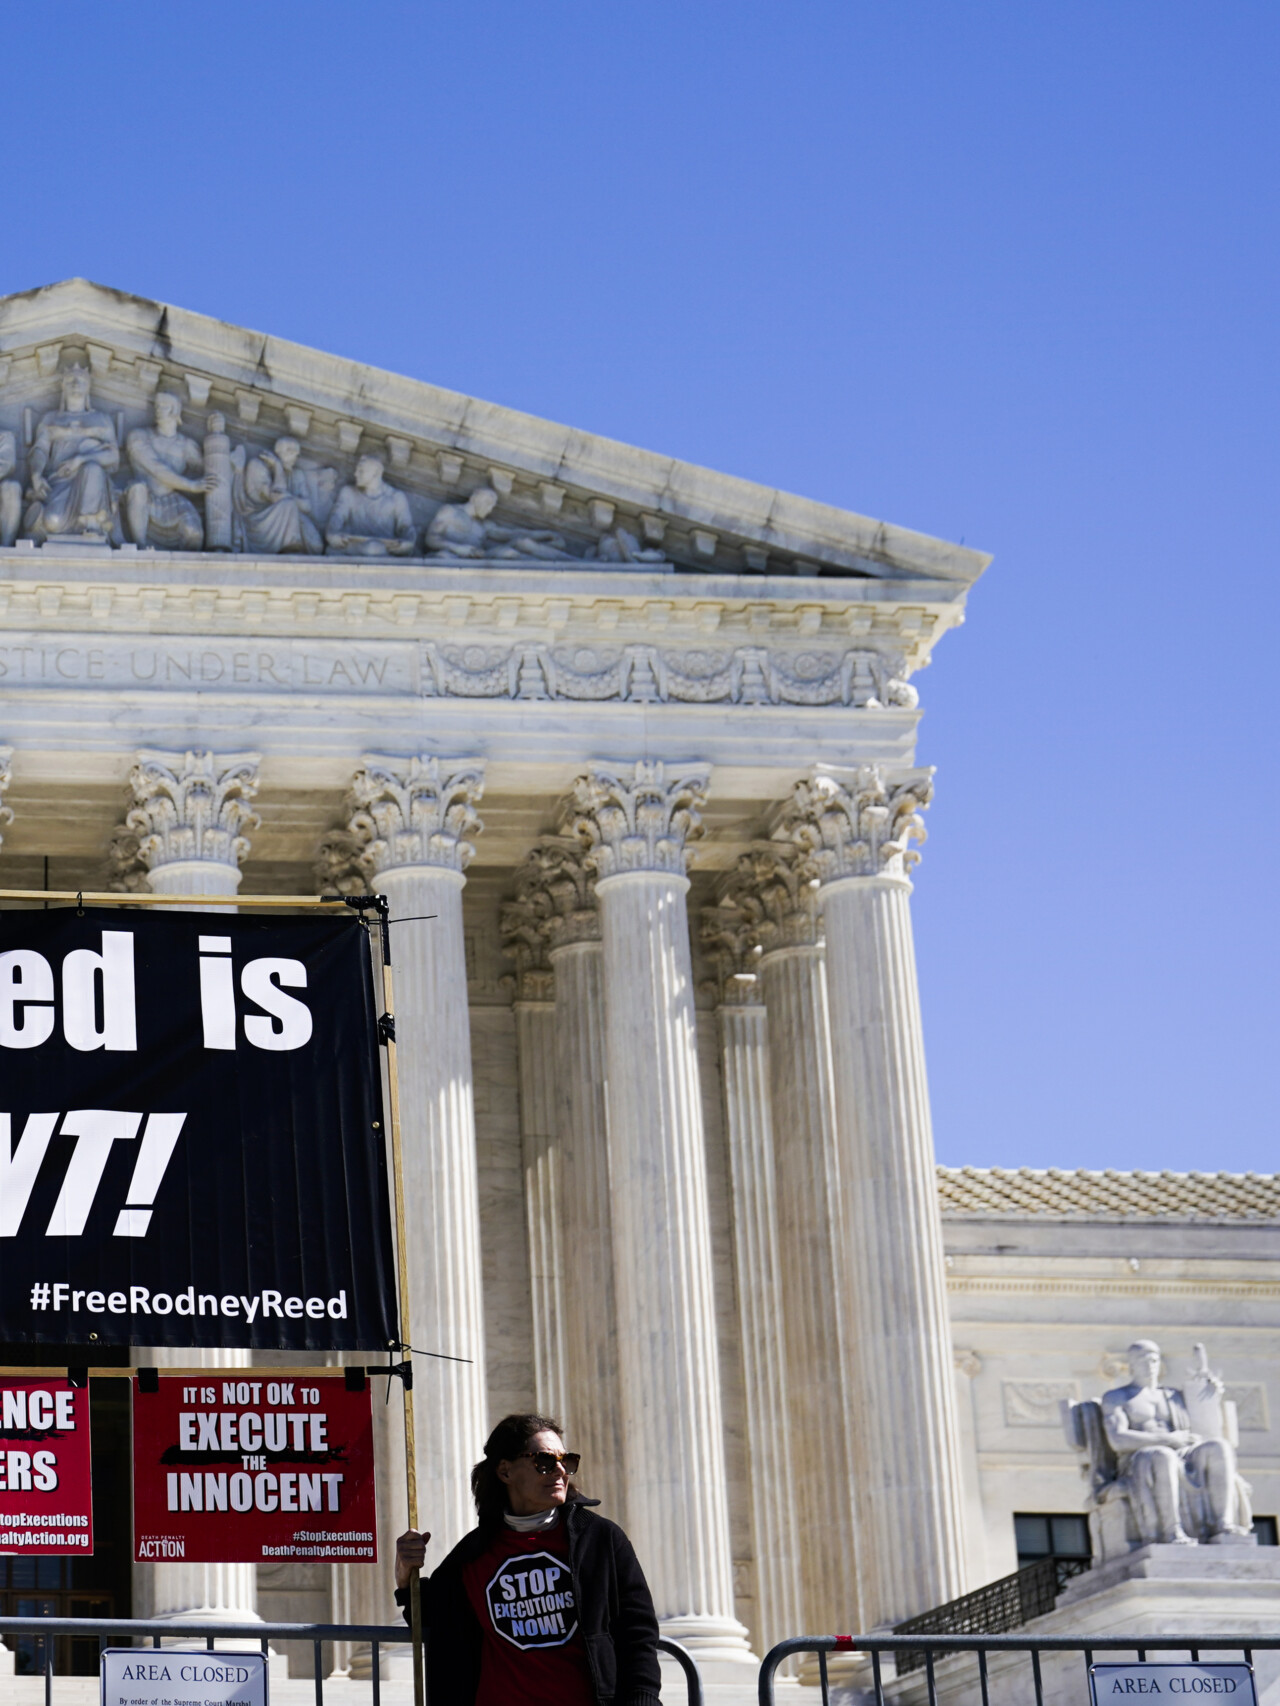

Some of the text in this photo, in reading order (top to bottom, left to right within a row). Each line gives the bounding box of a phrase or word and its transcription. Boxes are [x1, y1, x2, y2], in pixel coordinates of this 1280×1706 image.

[129, 650, 282, 683] UNDER
[302, 654, 390, 686] LAW
[199, 934, 313, 1052] is
[29, 1281, 349, 1325] #FreeRodneyReed
[183, 1382, 320, 1405] IT IS NOT OK TO
[179, 1412, 329, 1452] EXECUTE
[241, 1455, 267, 1471] THE
[166, 1472, 344, 1512] INNOCENT
[138, 1540, 185, 1557] ACTION
[292, 1531, 373, 1543] #StopExecutions
[262, 1545, 374, 1558] DeathPenaltyAction.org
[499, 1567, 561, 1601] STOP
[494, 1591, 575, 1619] EXECUTIONS
[511, 1613, 567, 1637] NOW!
[121, 1664, 250, 1683] AREA CLOSED
[1111, 1677, 1237, 1694] AREA CLOSED
[119, 1697, 128, 1706] By
[130, 1697, 148, 1706] order
[151, 1697, 159, 1706] of
[161, 1698, 172, 1706] the
